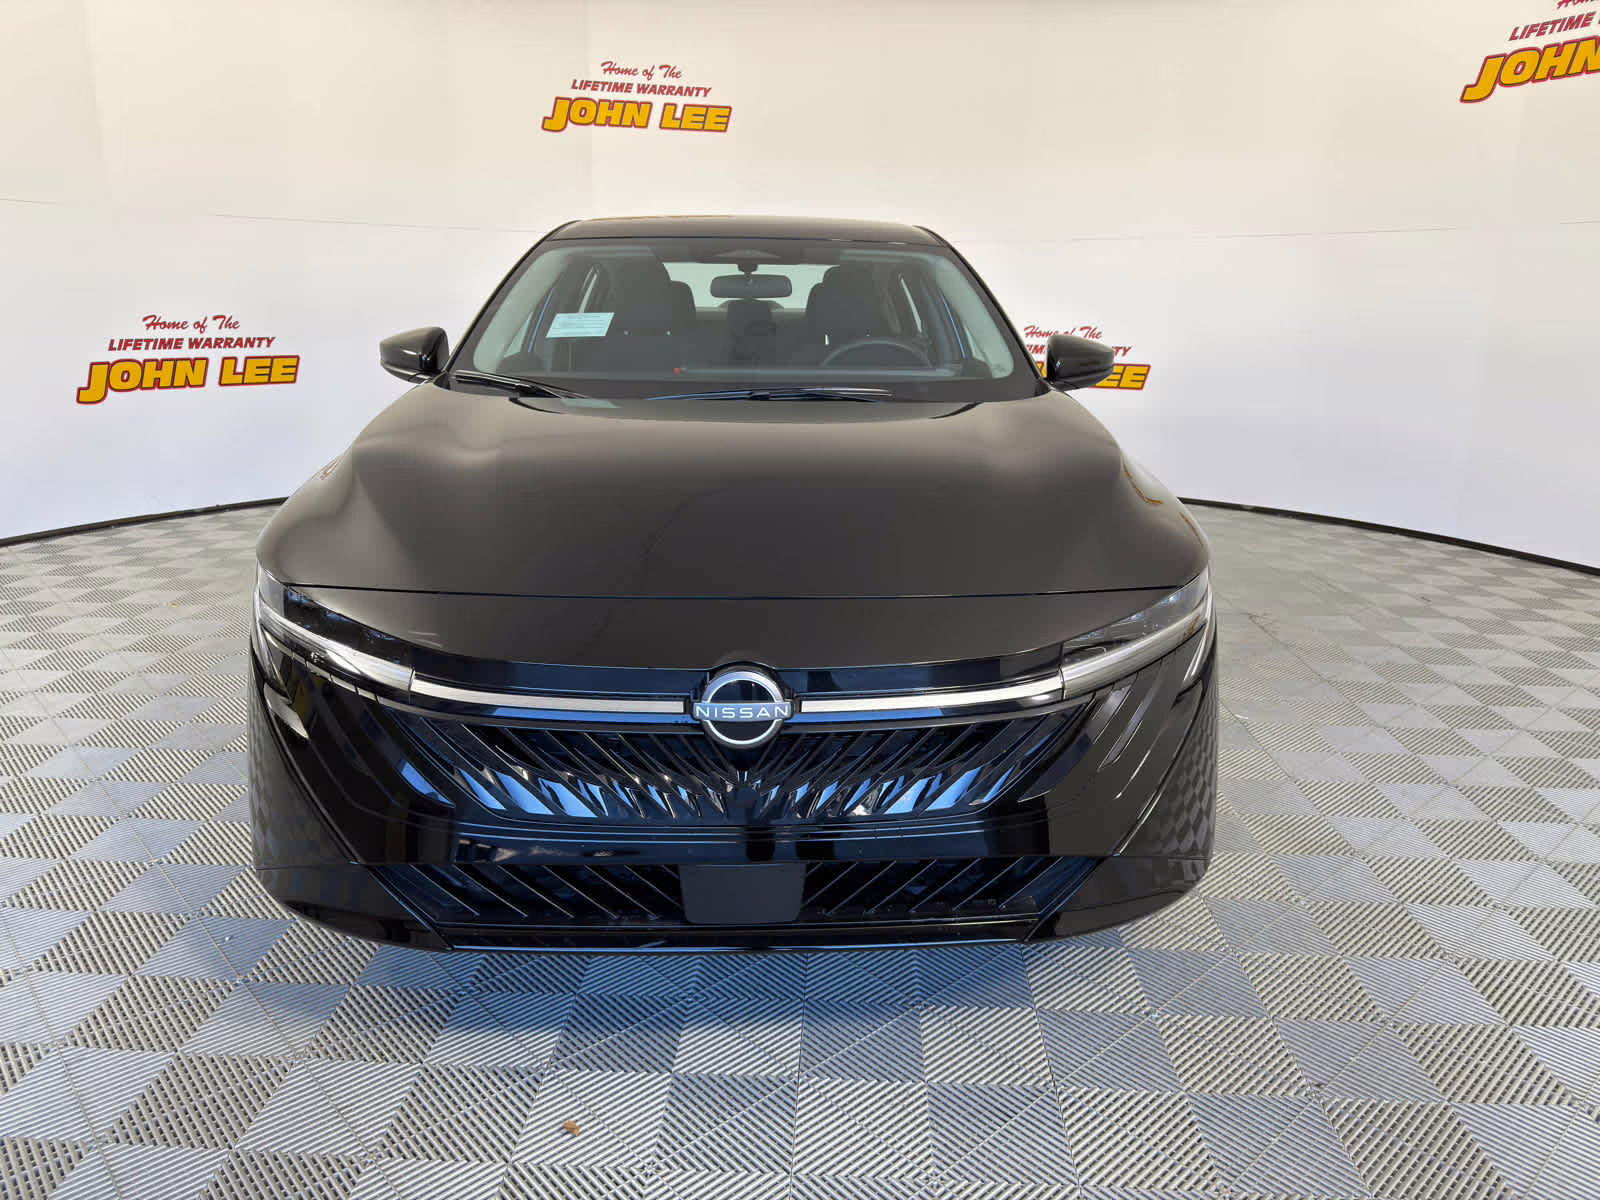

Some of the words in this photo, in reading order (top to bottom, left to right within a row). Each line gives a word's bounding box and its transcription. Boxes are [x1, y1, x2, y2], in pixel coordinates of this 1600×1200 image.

[1509, 11, 1597, 41] LIFETIME
[601, 61, 639, 77] Home
[642, 65, 655, 81] of
[659, 64, 682, 79] The
[571, 79, 633, 94] LIFETIME
[637, 83, 712, 98] WARRANTY
[541, 96, 653, 132] JOHN
[659, 103, 732, 132] LEE
[142, 314, 189, 331] Home
[193, 316, 207, 334] of
[212, 314, 240, 331] The
[1079, 326, 1102, 339] The
[108, 338, 184, 351] LIFETIME
[188, 336, 276, 350] WARRANTY
[76, 357, 209, 405] JOHN
[218, 354, 300, 387] LEE
[695, 705, 789, 719] NISSAN
